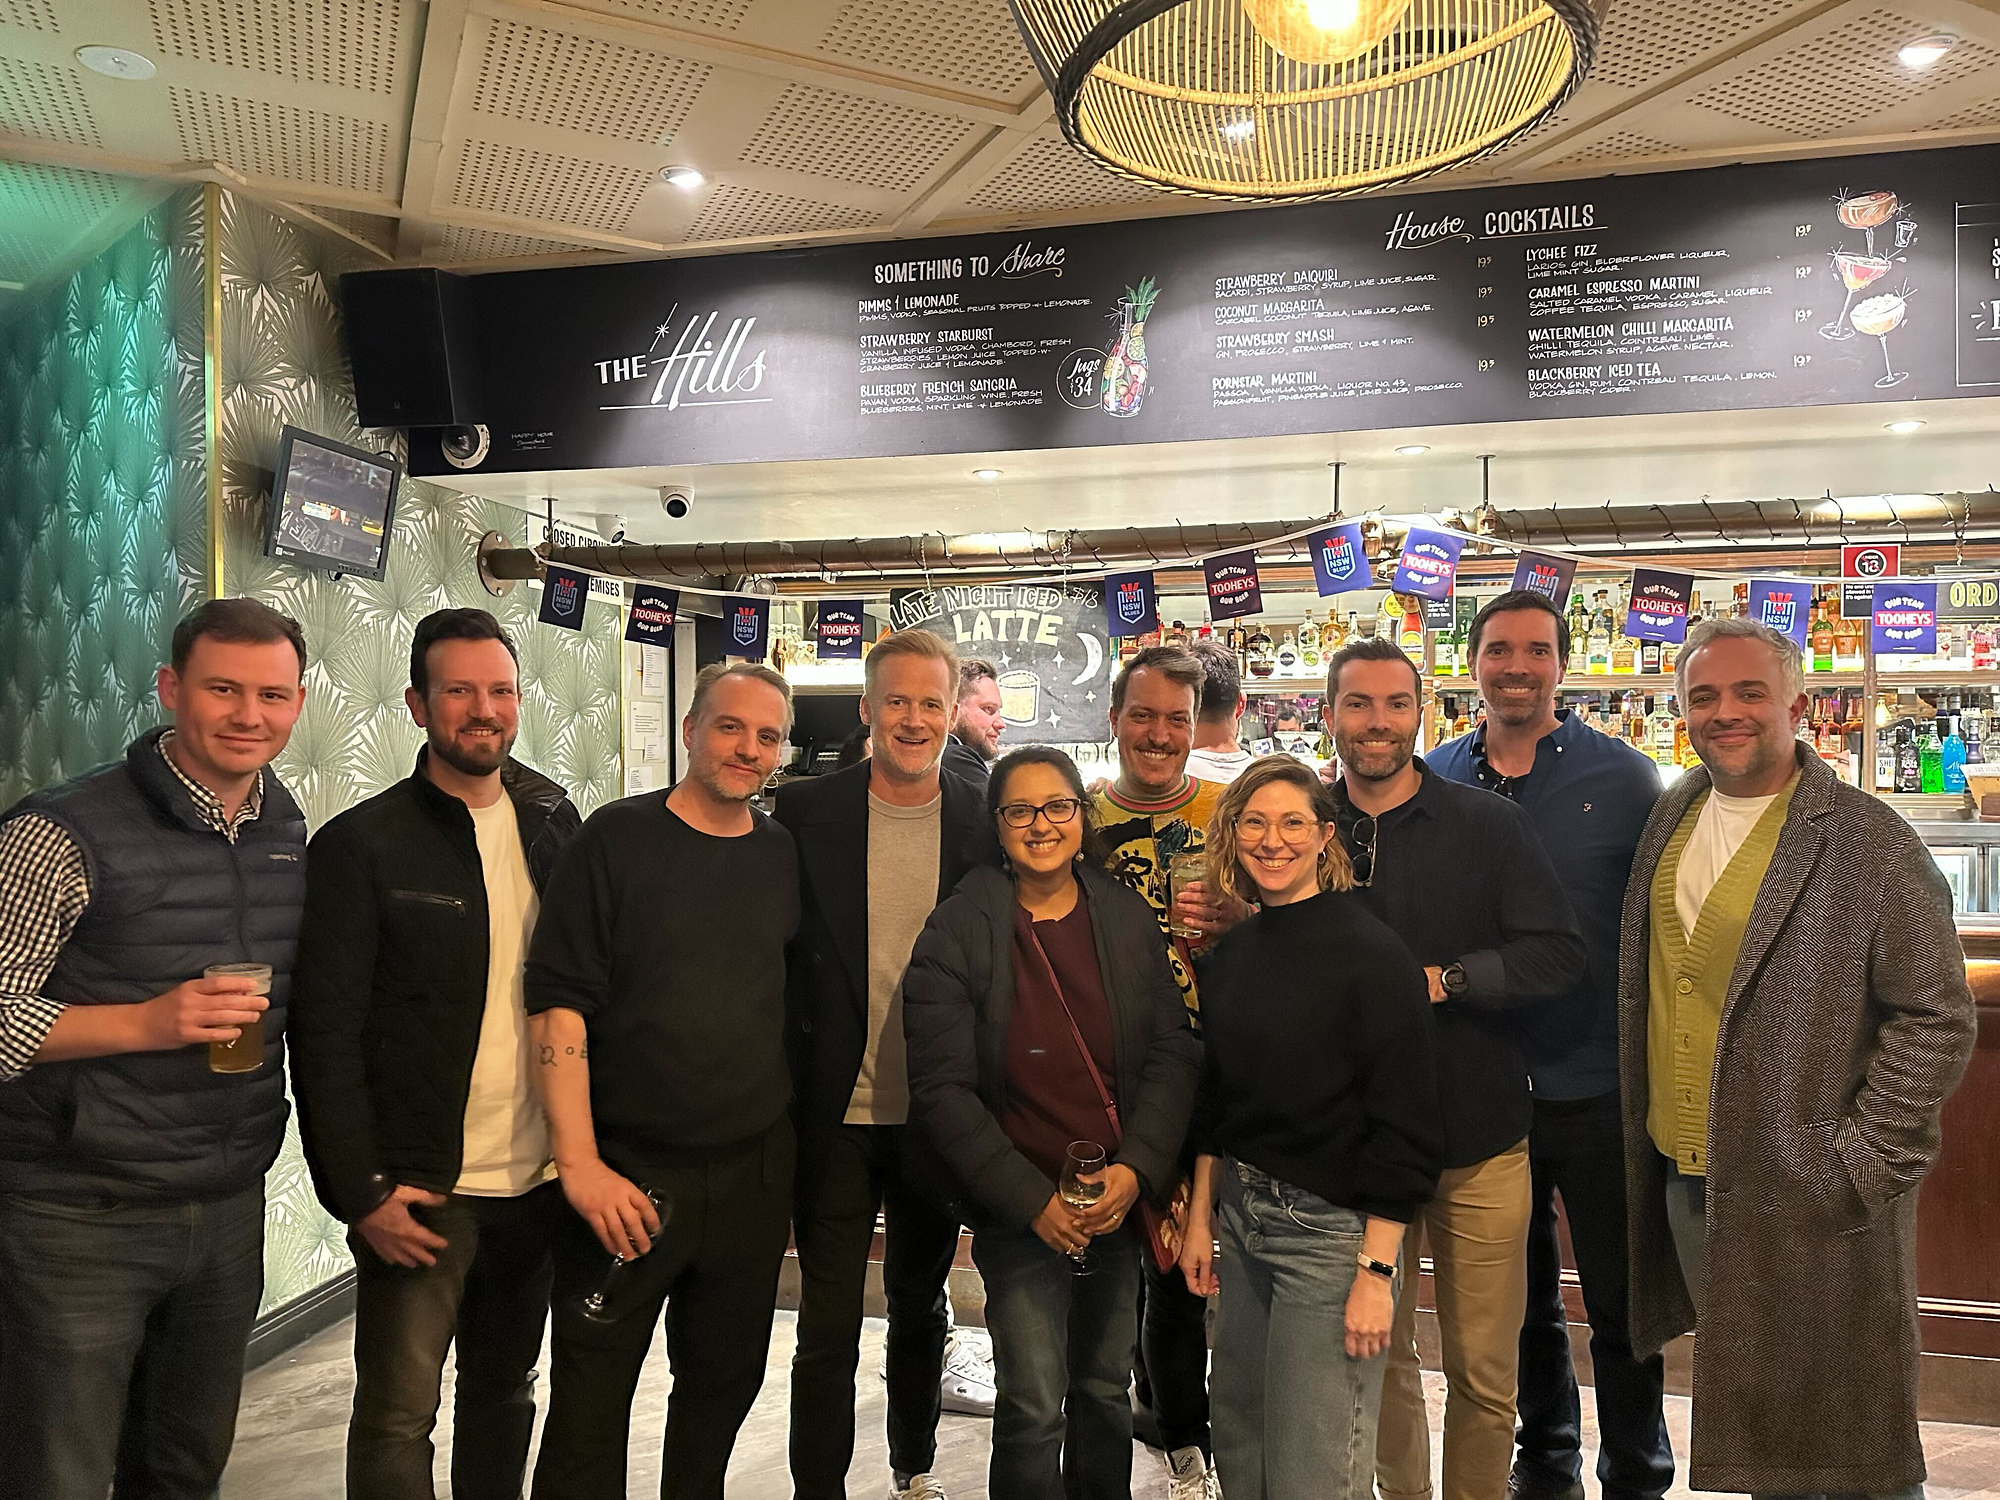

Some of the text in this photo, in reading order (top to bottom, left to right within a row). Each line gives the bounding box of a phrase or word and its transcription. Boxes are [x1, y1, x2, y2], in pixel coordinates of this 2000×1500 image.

[1385, 204, 1594, 251] House COCKTAILS
[1526, 244, 1598, 262] LYCHEE FIZZ
[1528, 250, 1730, 271] LARIOS ELDERFLOWER LIQUEUR,
[875, 241, 1065, 284] SOMETHING TO Share
[1215, 269, 1338, 291] STRAWBERRY DAIQUIRI
[1528, 265, 1623, 280] LIME MINT SUGAR.
[1256, 284, 1316, 296] STRAWBERRY
[1321, 281, 1352, 290] SYRUP,
[1354, 279, 1375, 287] LIME
[1529, 276, 1700, 299] CARAMEL ESPRESSO MARTINI
[859, 293, 960, 314] PIMMS LEMONADE
[1530, 287, 1772, 309] SALTED CARAMEL CARAMEL LIQUEUR
[923, 307, 965, 316] SEASONAL
[967, 304, 996, 312] FRUITS
[999, 302, 1031, 311] TOPPED
[1044, 298, 1093, 308] LEMONADE.
[1215, 298, 1325, 319] COCONUT MARGARITA
[1530, 307, 1574, 317] COFFEE
[1633, 301, 1688, 309] ESPRESSO,
[1264, 313, 1306, 322] COCONUT
[860, 327, 994, 348] STRAWBERRY STARBURST
[1528, 317, 1734, 341] WATERMELON CHILLI MARGARITA
[1216, 327, 1334, 349] STRAWBERRY SMASH
[1359, 340, 1380, 348] LIME
[1529, 342, 1561, 351] CHILLI
[861, 338, 1072, 358] VANILLA INFUSED CHAMBORD, FRESH
[936, 353, 968, 361] LEMON
[971, 351, 996, 359] JUICE
[1002, 349, 1037, 357] TOPPED
[1529, 348, 1602, 360] WATERMELON
[1606, 347, 1643, 356] SYRUP,
[1646, 344, 1681, 352] AGAVE
[594, 311, 767, 411] THE Hills
[860, 363, 914, 373] CRANBERRY
[917, 361, 942, 370] JUICE
[1067, 358, 1100, 379] Jugs
[1528, 362, 1661, 381] BLACKBERRY ICED TEA
[860, 378, 1018, 397] BLUEBERRY FRENCH SANGRIA
[1212, 371, 1317, 390] PORNSTAR MARTINI
[924, 394, 976, 403] SPARKLING
[1011, 390, 1043, 398] FRESH
[1529, 388, 1596, 399] BLACKBERRY
[952, 402, 974, 410] LIME
[990, 399, 1043, 408] LEMONADE
[543, 525, 575, 549] COSED
[1329, 557, 1350, 568] NSW
[1405, 556, 1450, 575] TOOHEYS
[1862, 560, 1880, 573] 18
[1215, 566, 1247, 579] OUR TEAM
[591, 578, 620, 598] EMISES
[1212, 577, 1254, 594] TOOHEYS
[1643, 585, 1680, 599] OUR TEAM
[1950, 582, 2000, 608] ORD
[890, 589, 943, 633] LATE
[942, 586, 1015, 612] NIGHT
[1017, 587, 1063, 613] ICED
[1122, 603, 1141, 611] NSW
[1635, 598, 1684, 614] TOOHEYS
[635, 608, 672, 623] TOOHEYS
[827, 612, 855, 622] OUR TEAM
[1766, 615, 1790, 624] NSW
[1878, 613, 1931, 625] TOOHEYS
[737, 625, 754, 634] NSW
[822, 625, 859, 634] TOOHEYS
[952, 610, 1064, 648] LATTE
